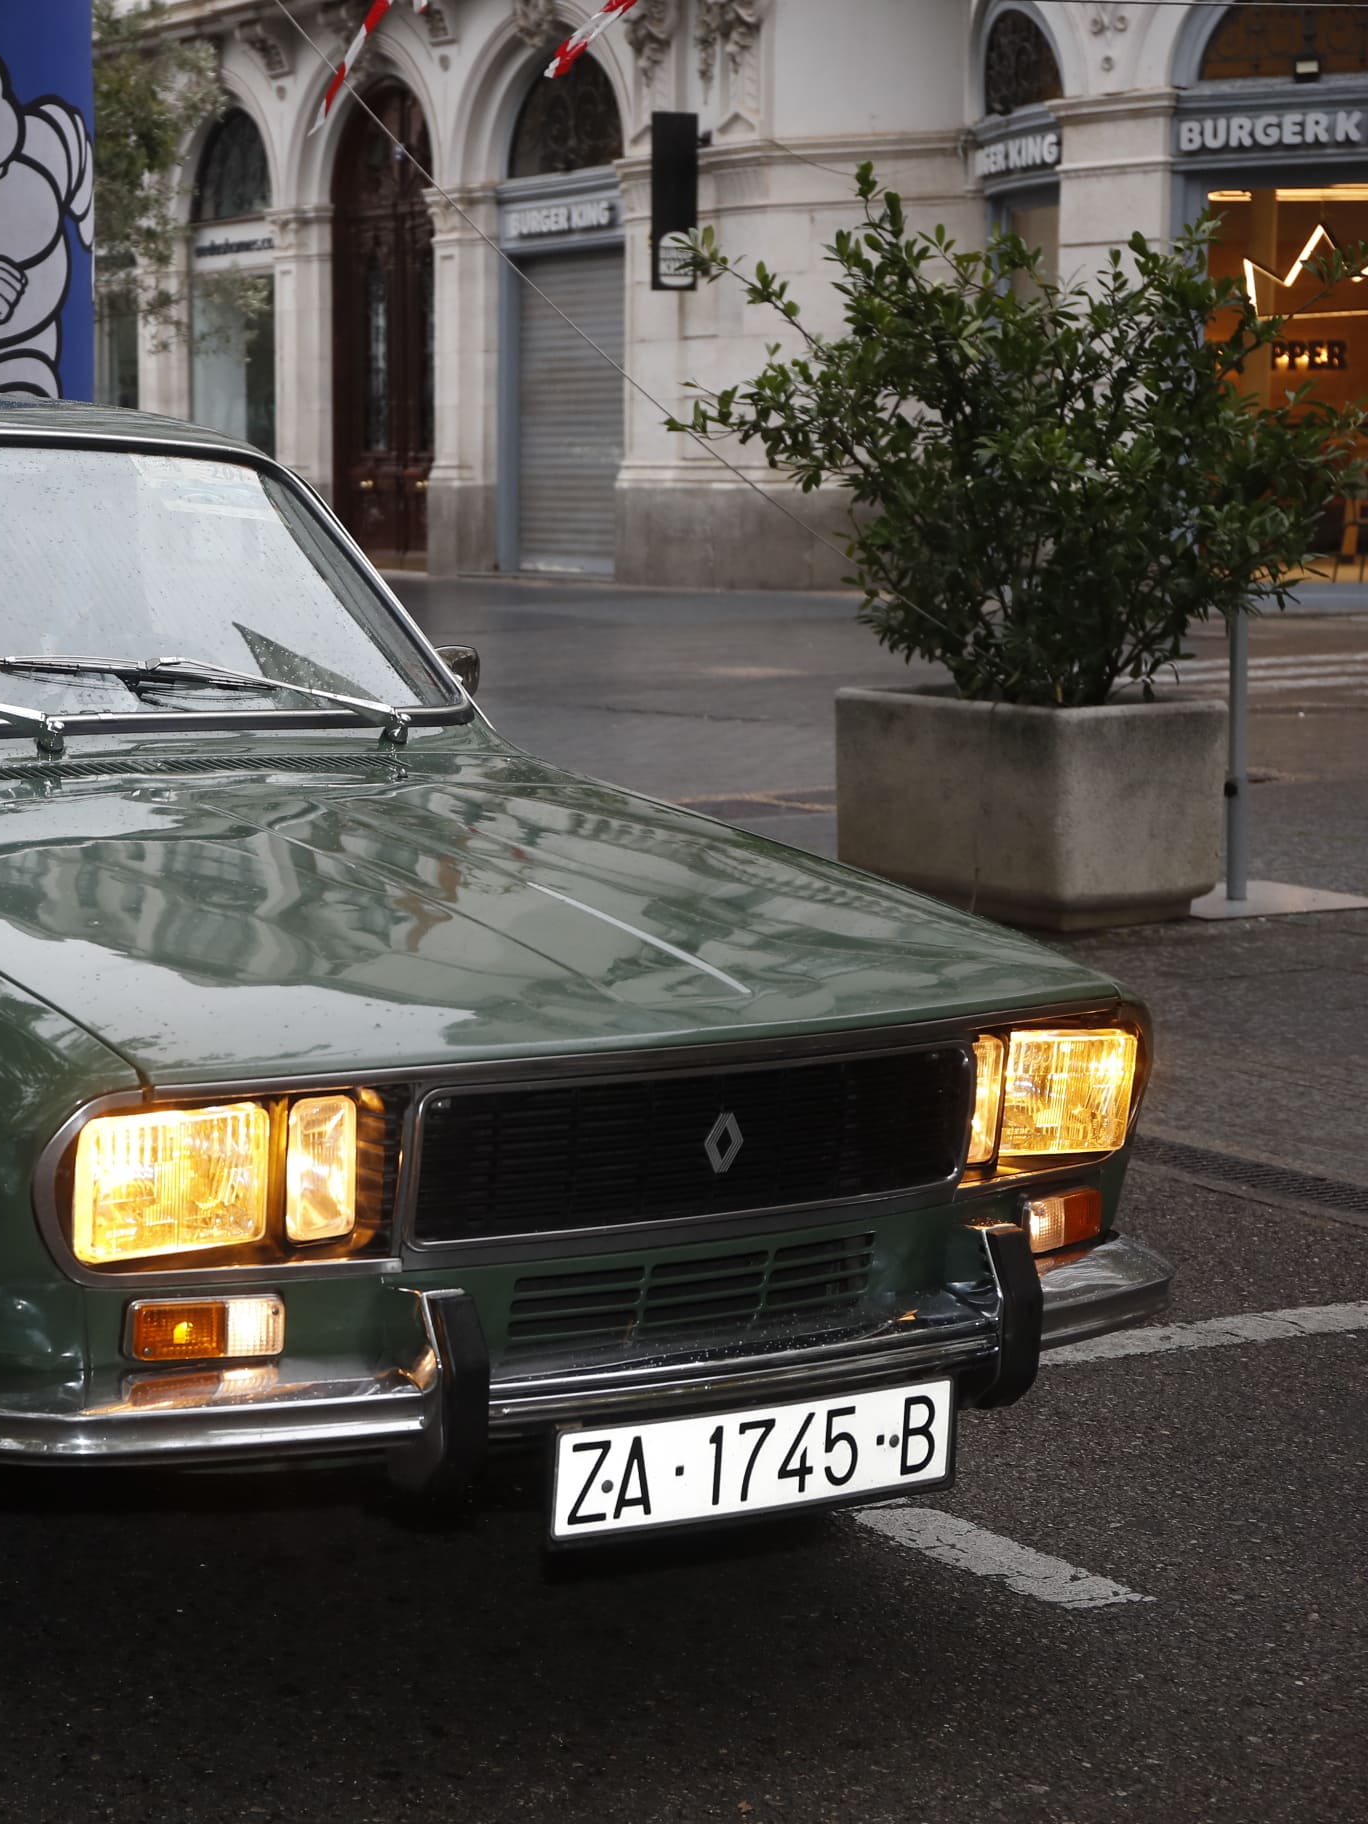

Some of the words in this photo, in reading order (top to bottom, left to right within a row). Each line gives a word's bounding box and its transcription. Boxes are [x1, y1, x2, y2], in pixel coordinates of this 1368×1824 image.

[1179, 112, 1330, 151] BURGER
[1008, 133, 1059, 170] KING
[506, 207, 569, 238] BURGER
[570, 200, 610, 229] KING
[1271, 340, 1348, 371] PPER
